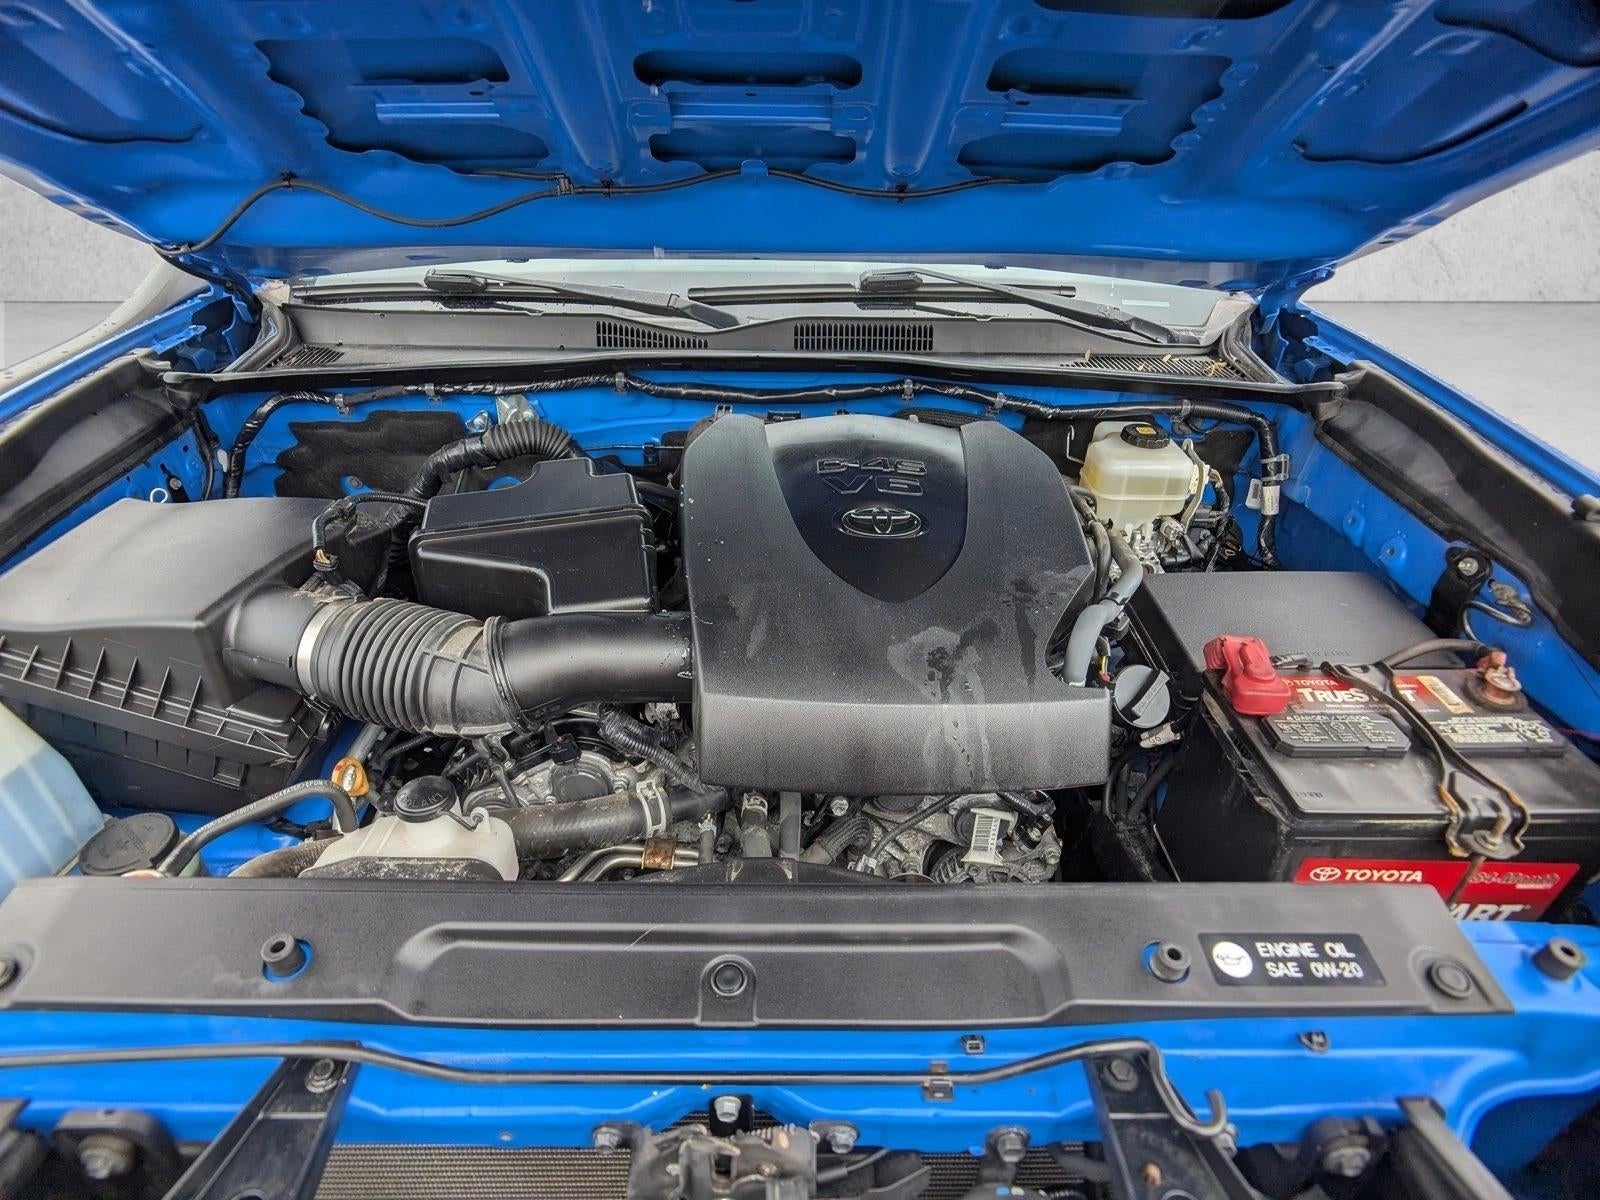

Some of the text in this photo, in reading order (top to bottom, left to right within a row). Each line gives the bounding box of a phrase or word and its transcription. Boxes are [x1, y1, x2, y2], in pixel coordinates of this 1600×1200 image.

[1295, 679, 1339, 687] TOYOTA
[1345, 869, 1423, 883] TOYOTA
[1255, 941, 1356, 959] ENGINE OIL
[1265, 961, 1364, 978] SAE 0W-20
